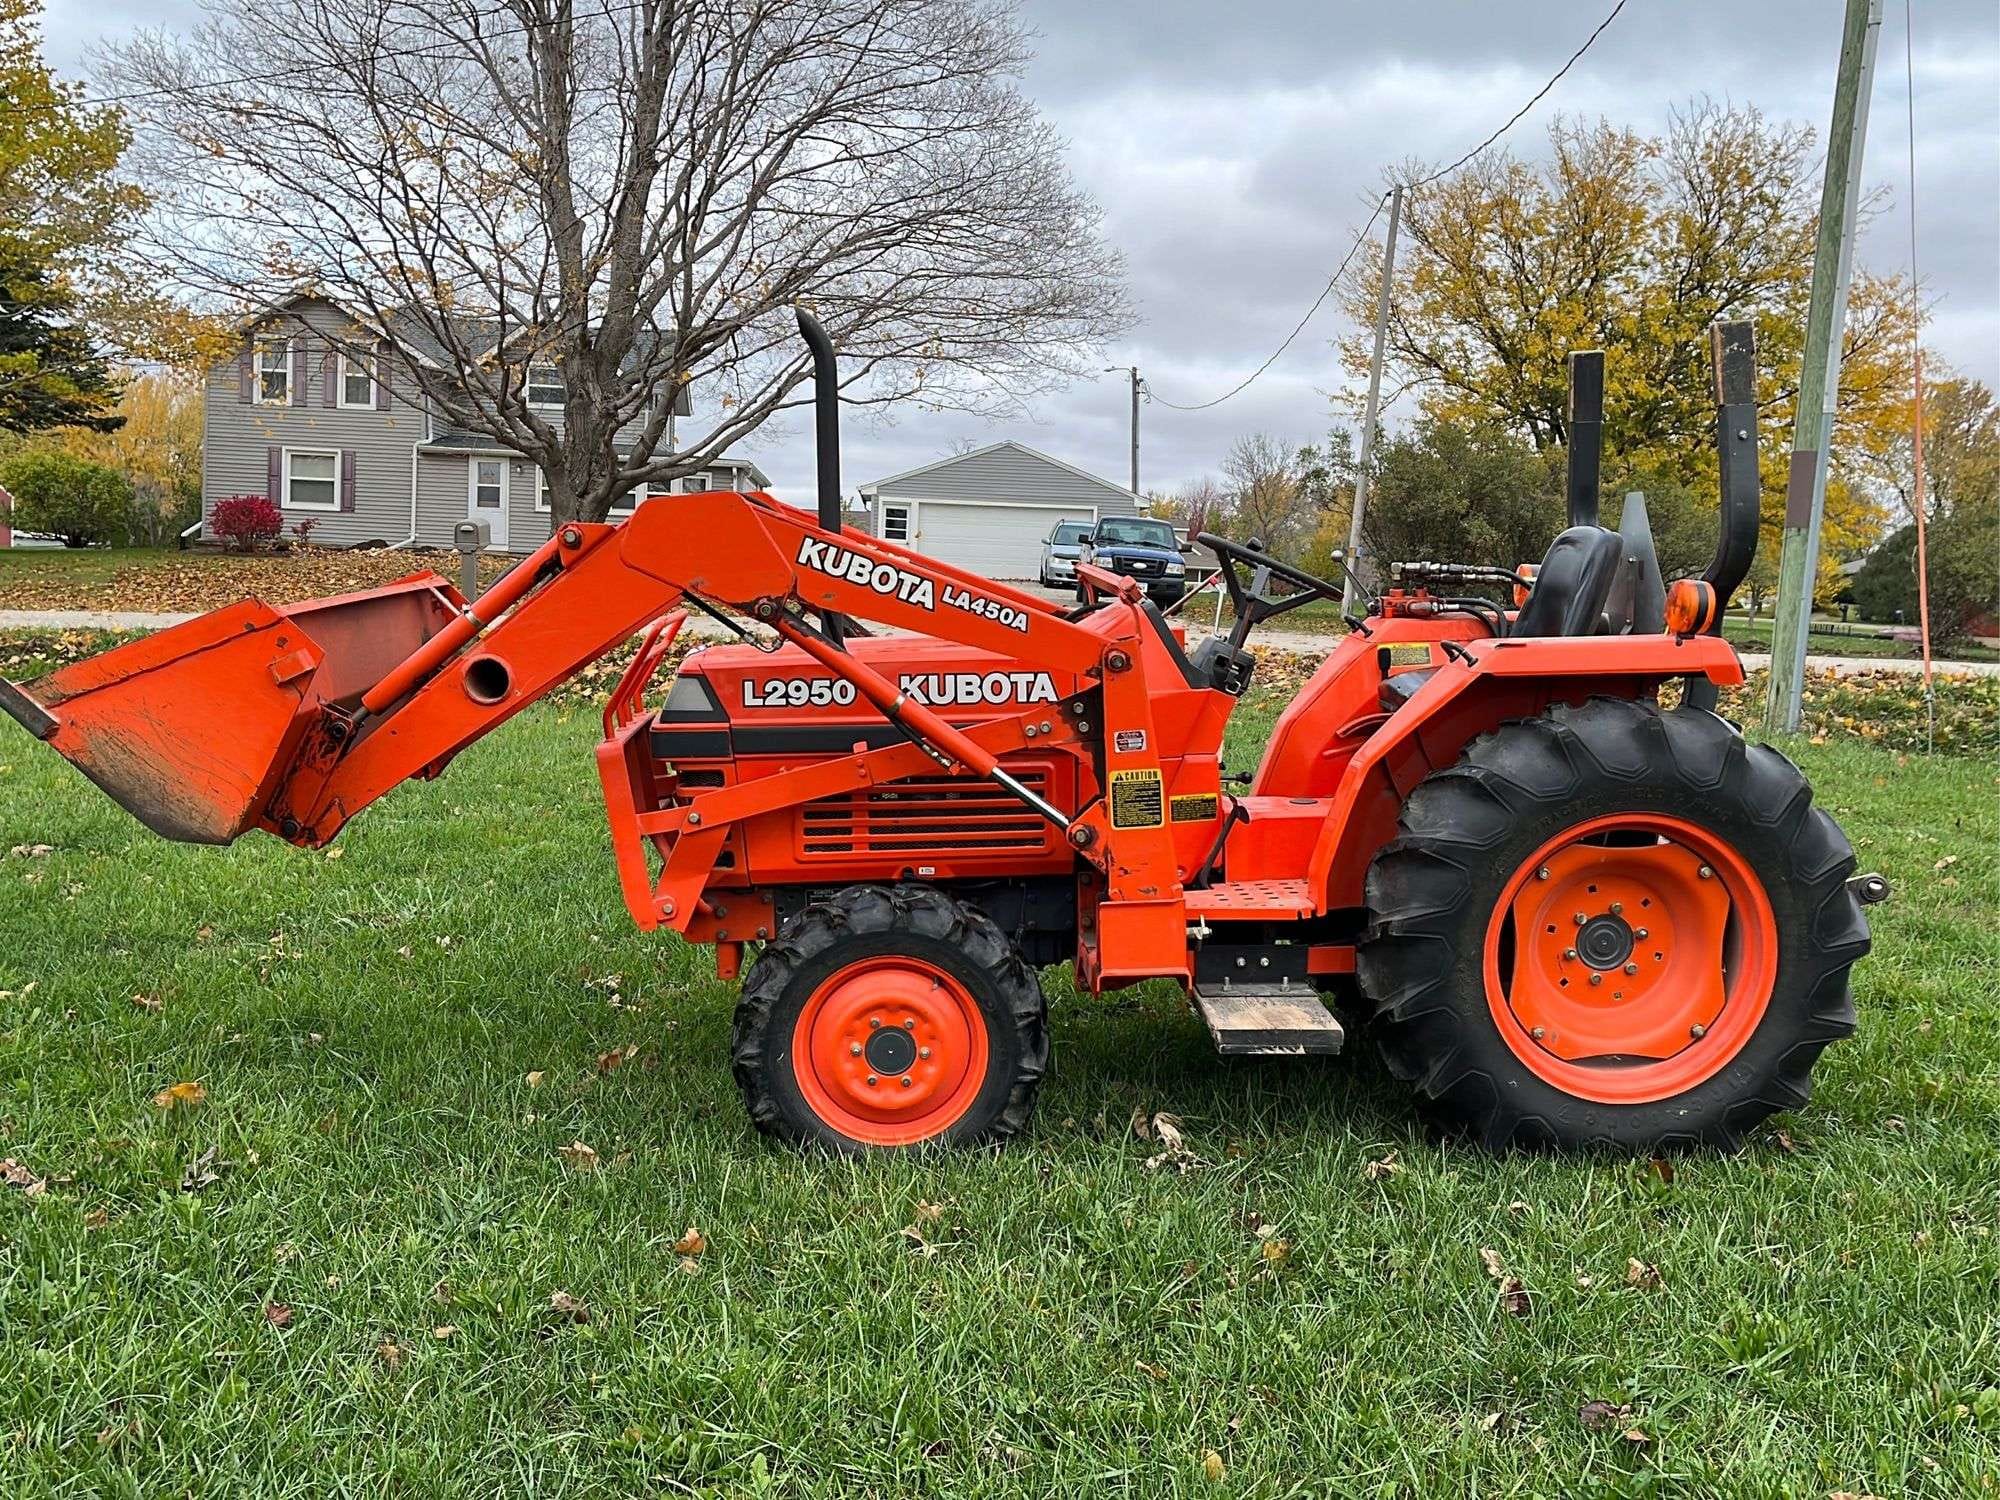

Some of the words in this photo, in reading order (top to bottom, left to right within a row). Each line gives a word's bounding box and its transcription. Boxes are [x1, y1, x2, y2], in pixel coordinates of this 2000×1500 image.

[798, 537, 935, 610] KUBOTA
[942, 587, 1028, 632] LA450A
[743, 679, 856, 707] L2950
[900, 673, 1058, 705] KUBOTA
[1125, 771, 1158, 781] CAUTION
